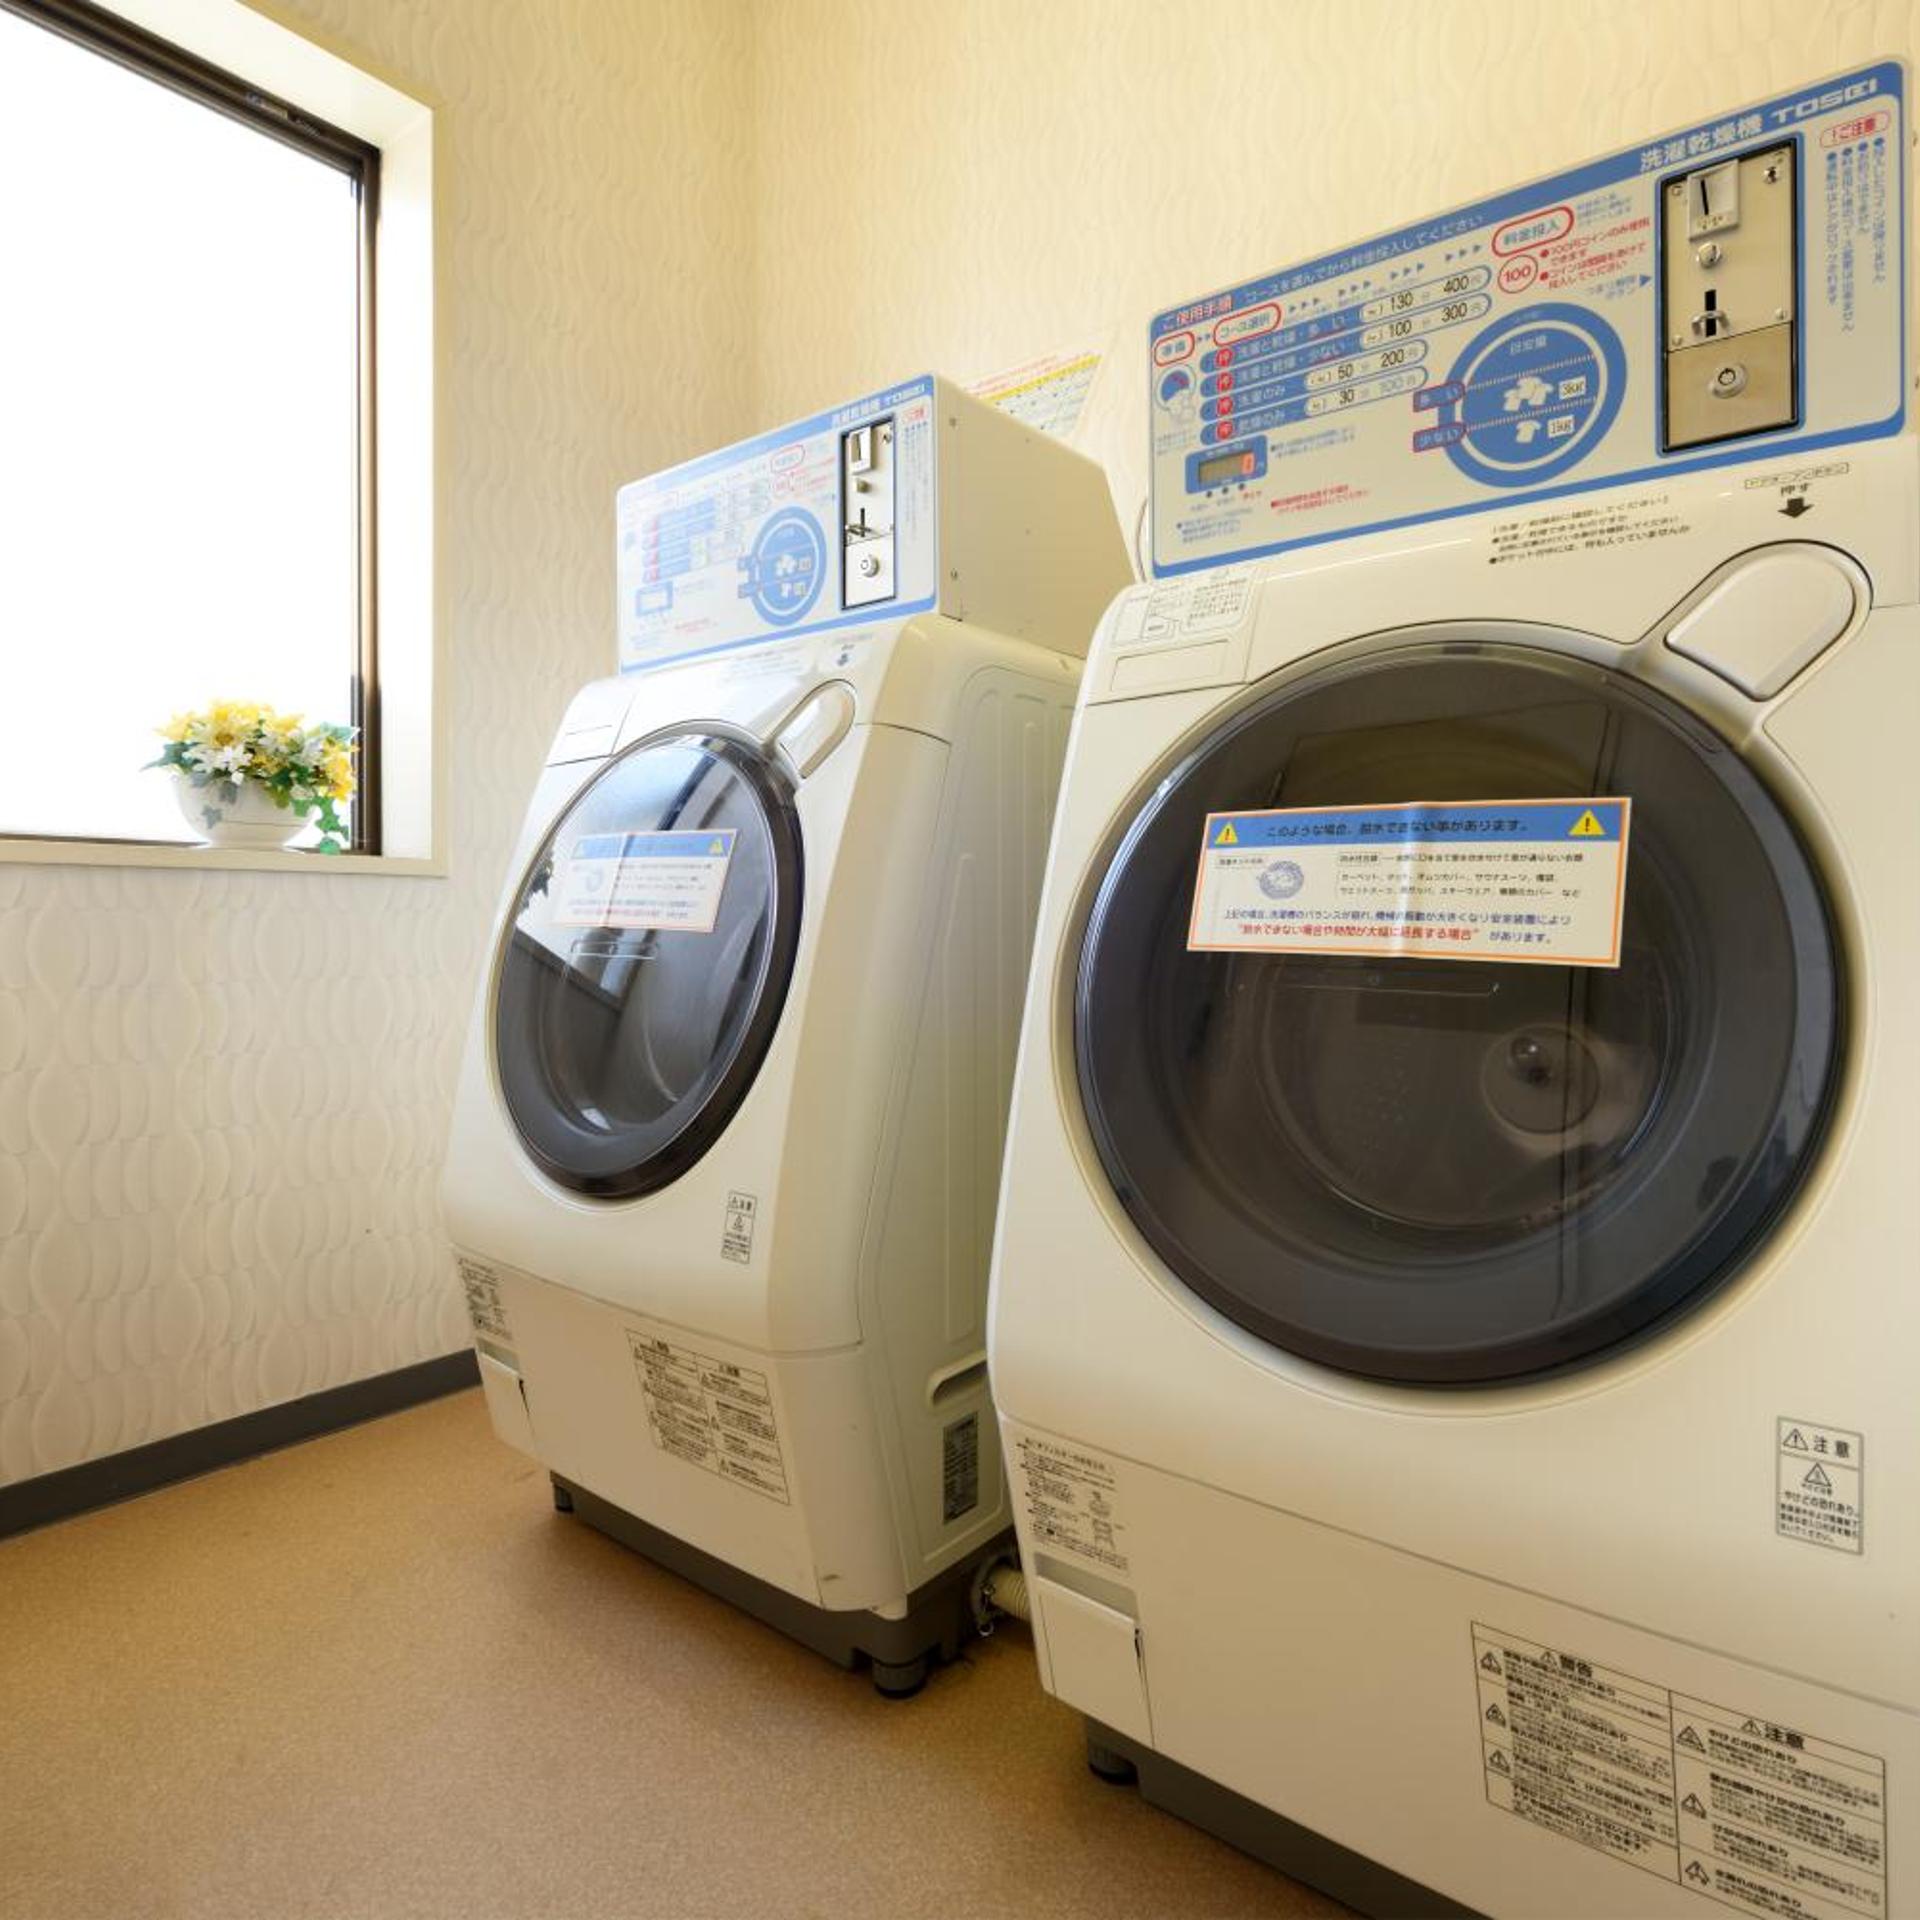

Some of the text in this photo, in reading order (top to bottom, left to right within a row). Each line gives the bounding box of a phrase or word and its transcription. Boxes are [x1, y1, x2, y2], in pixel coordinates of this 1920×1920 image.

[1640, 78, 1878, 173] 洗濯乾燥機 TOSEI
[1503, 219, 1561, 246] 料金投入
[1504, 265, 1531, 283] 100
[1390, 291, 1414, 313] 130
[1443, 275, 1469, 294] 400
[1389, 319, 1412, 337] 100
[1441, 302, 1468, 323] 300
[1380, 348, 1405, 368] 200
[1339, 389, 1355, 404] 30
[1780, 482, 1810, 496] 押す
[1489, 930, 1553, 945] があります。
[1813, 1435, 1849, 1458] 注意
[1765, 1722, 1804, 1750] 注意
